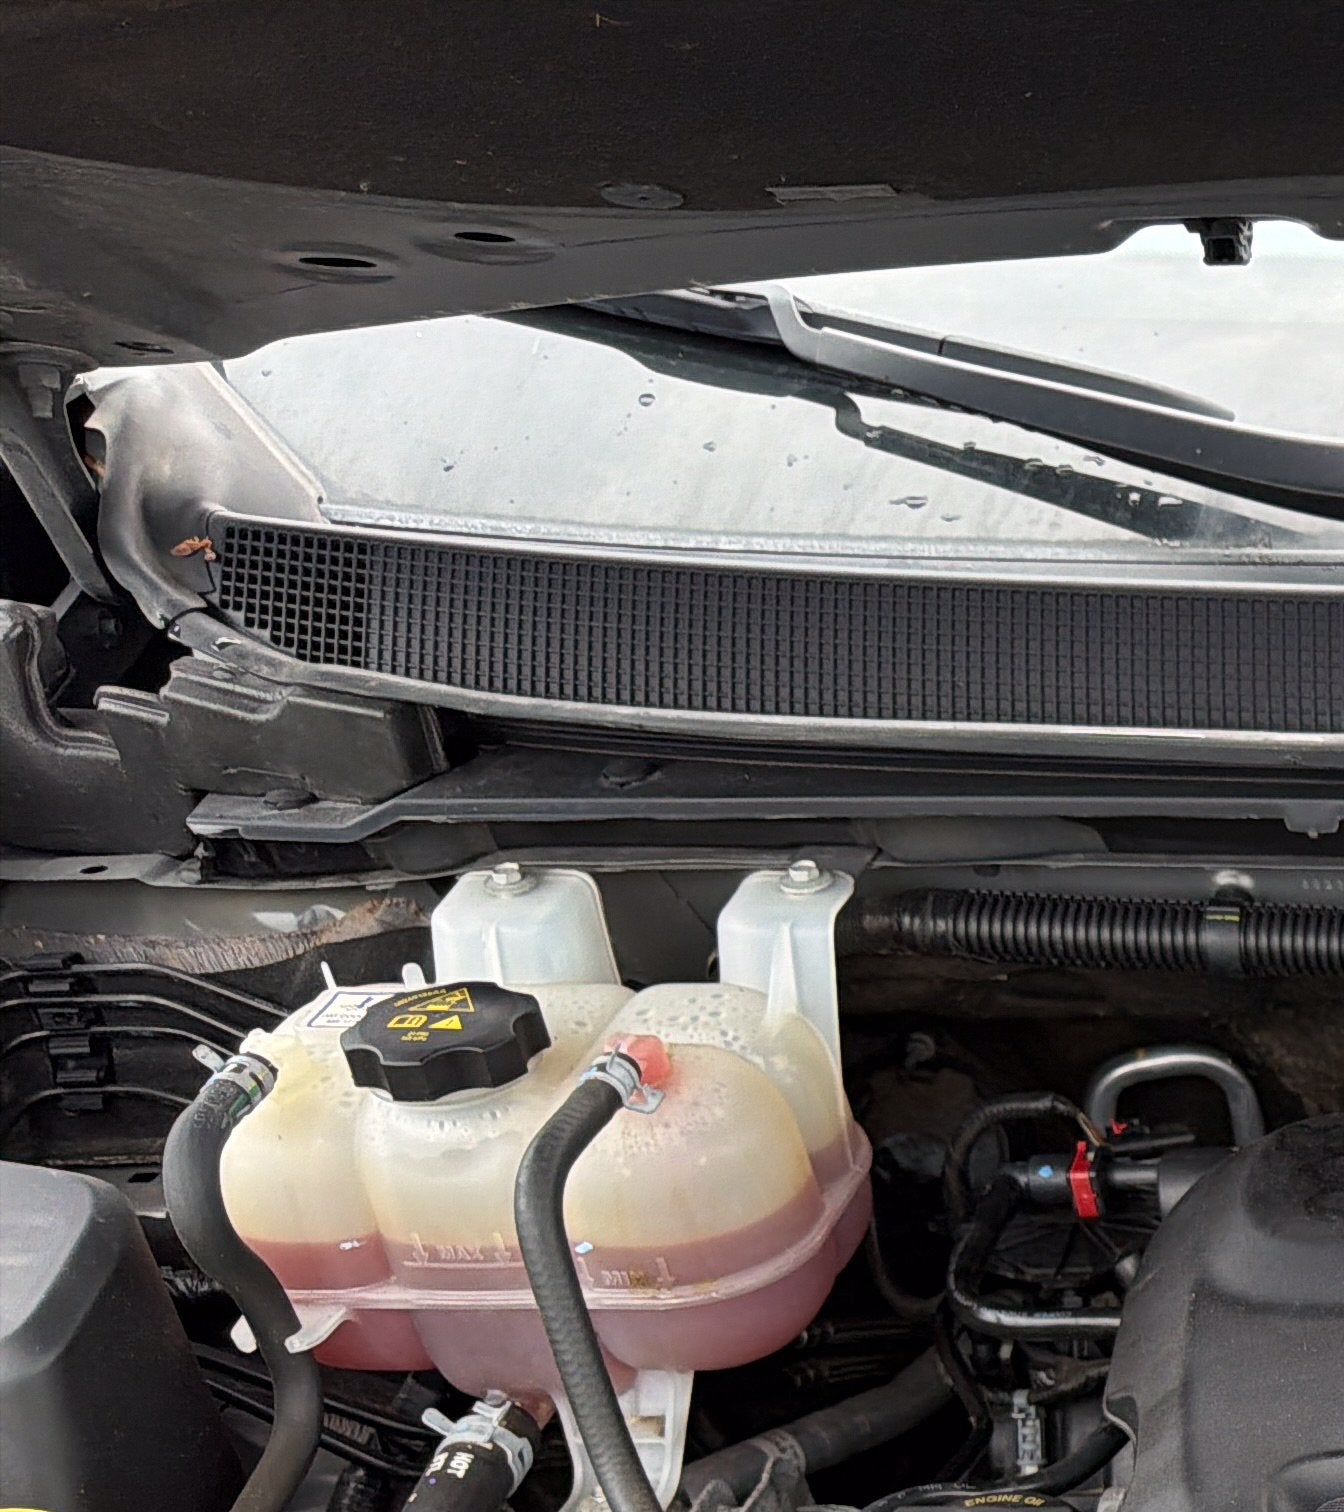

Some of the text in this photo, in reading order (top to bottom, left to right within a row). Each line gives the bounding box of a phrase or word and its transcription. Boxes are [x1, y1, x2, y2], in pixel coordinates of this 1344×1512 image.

[436, 1245, 484, 1261] MAX
[446, 1451, 475, 1479] HOT
[965, 1494, 1024, 1508] ENGINE
